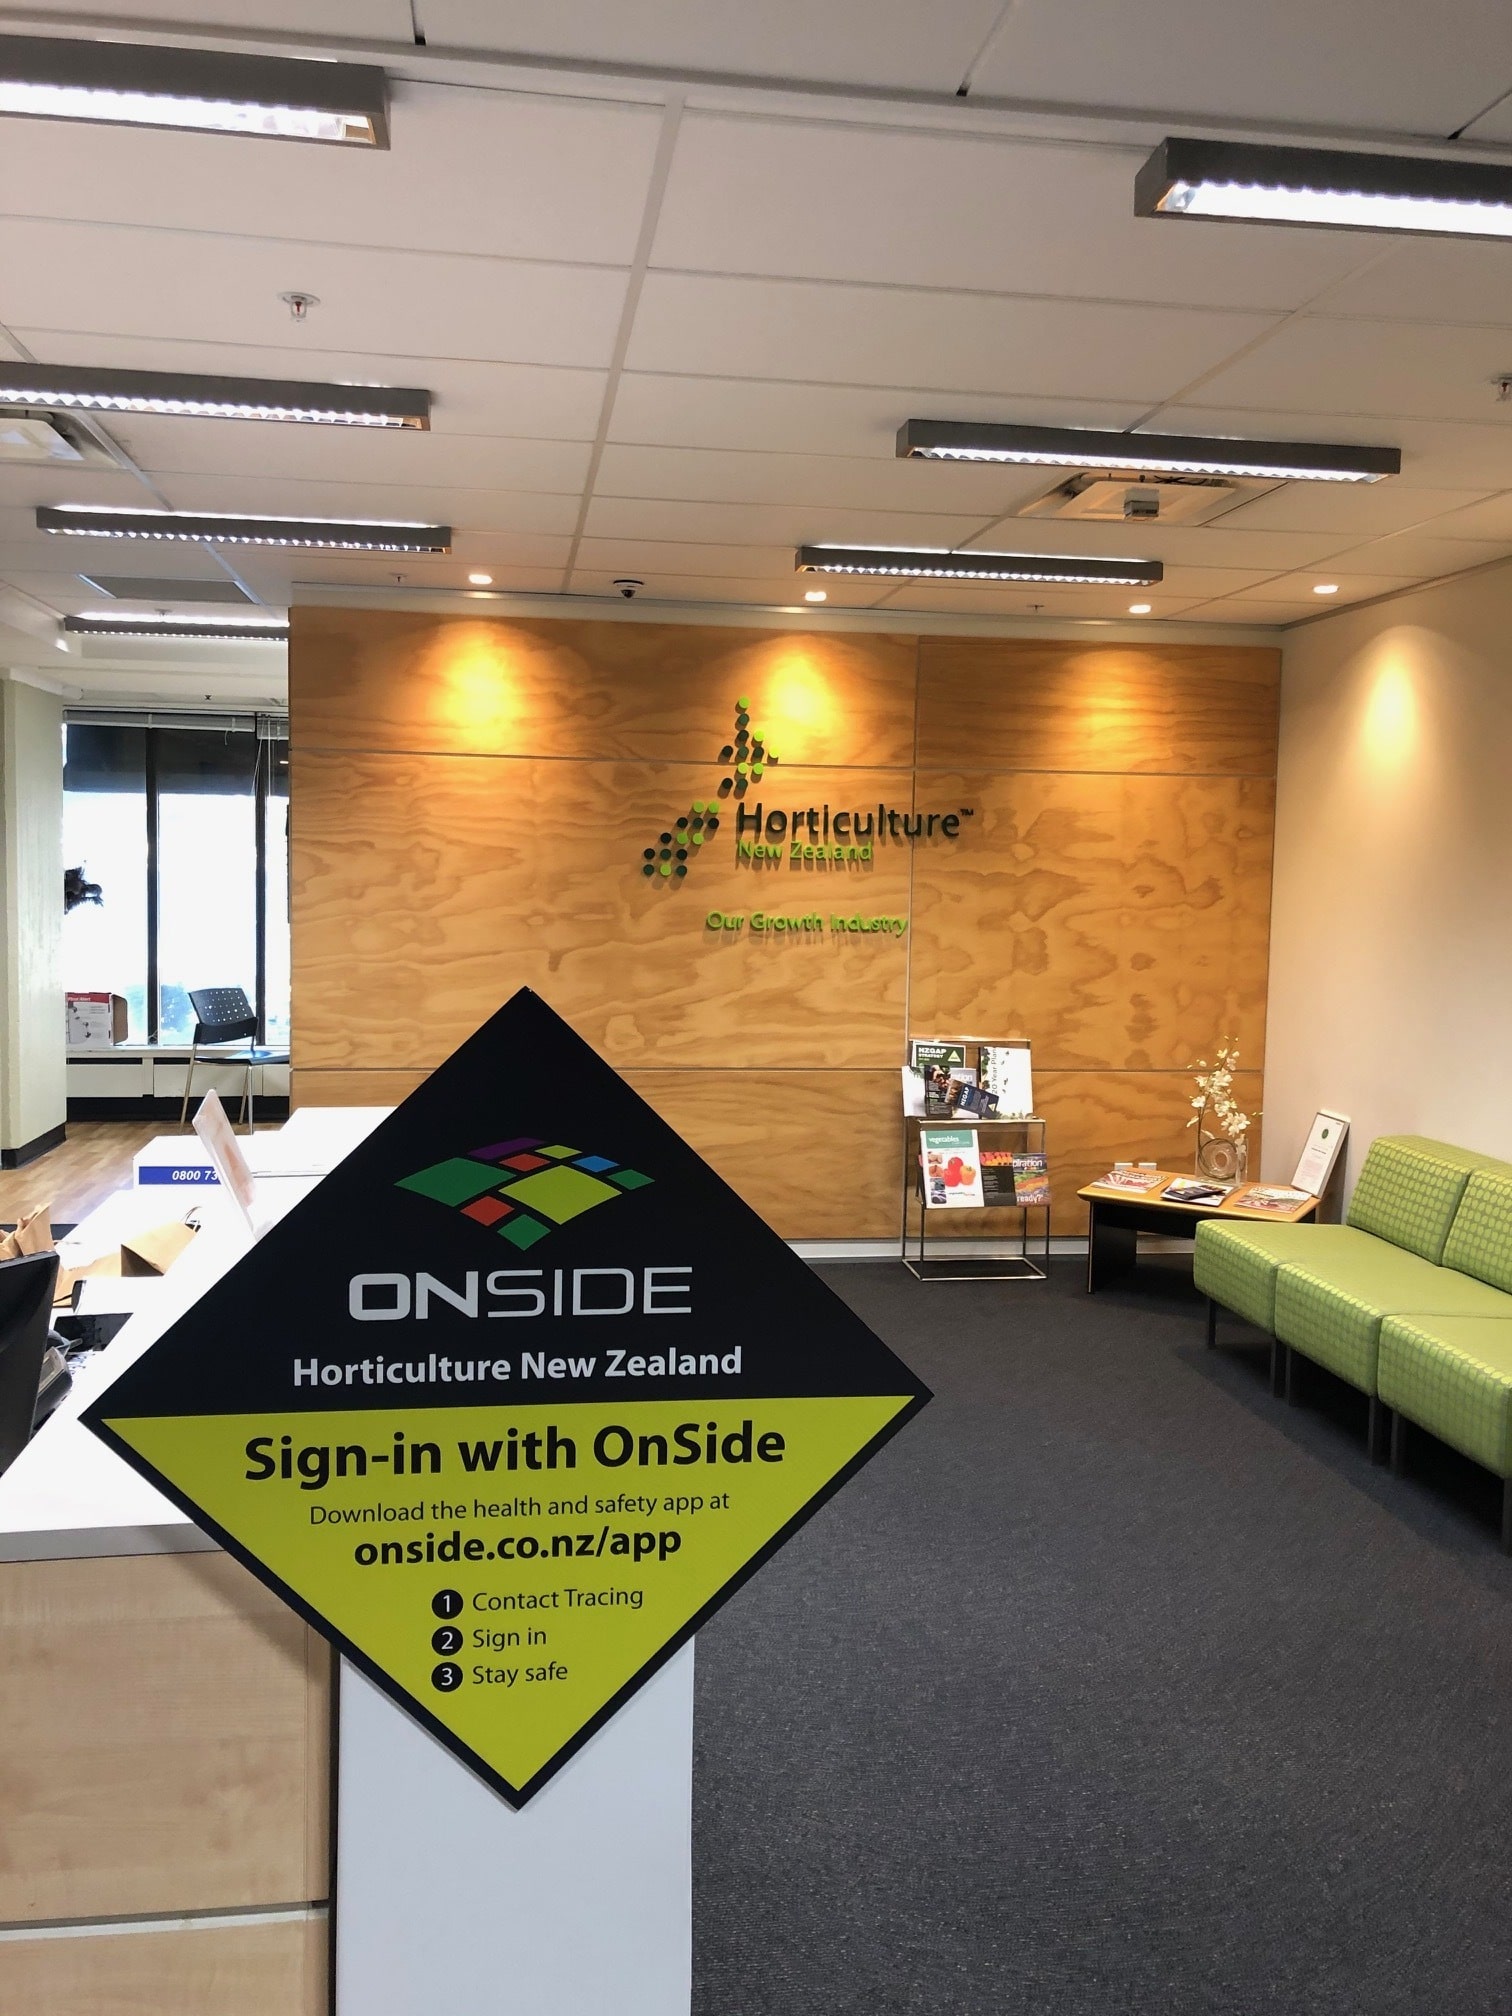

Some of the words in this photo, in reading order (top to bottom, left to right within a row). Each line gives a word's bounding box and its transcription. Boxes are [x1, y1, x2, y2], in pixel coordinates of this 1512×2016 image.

[738, 841, 782, 860] New
[790, 841, 873, 861] Zealand
[706, 911, 744, 930] Our
[750, 912, 823, 931] Growth
[830, 913, 908, 937] Industry
[991, 1048, 999, 1064] Plan
[991, 1065, 999, 1082] Year
[172, 1170, 201, 1181] 0800
[348, 1266, 693, 1321] ONSIDE
[293, 1354, 512, 1387] Horticulture
[521, 1351, 597, 1379] New
[605, 1346, 742, 1377] Zealand
[244, 1431, 442, 1490] Sign-in
[458, 1425, 577, 1472] with
[593, 1420, 787, 1468] OnSide
[309, 1503, 425, 1525] Download
[430, 1499, 468, 1521] the
[473, 1497, 542, 1520] health
[547, 1494, 589, 1517] and
[594, 1492, 659, 1517] safety
[663, 1495, 704, 1517] app
[708, 1492, 730, 1511] at
[354, 1526, 683, 1567] onside.co.nz/app
[472, 1590, 560, 1612] Contact
[565, 1587, 645, 1611] Tracing
[472, 1626, 519, 1653] Sign
[527, 1627, 547, 1646] in
[472, 1664, 519, 1690] Stay
[524, 1662, 569, 1684] safe
